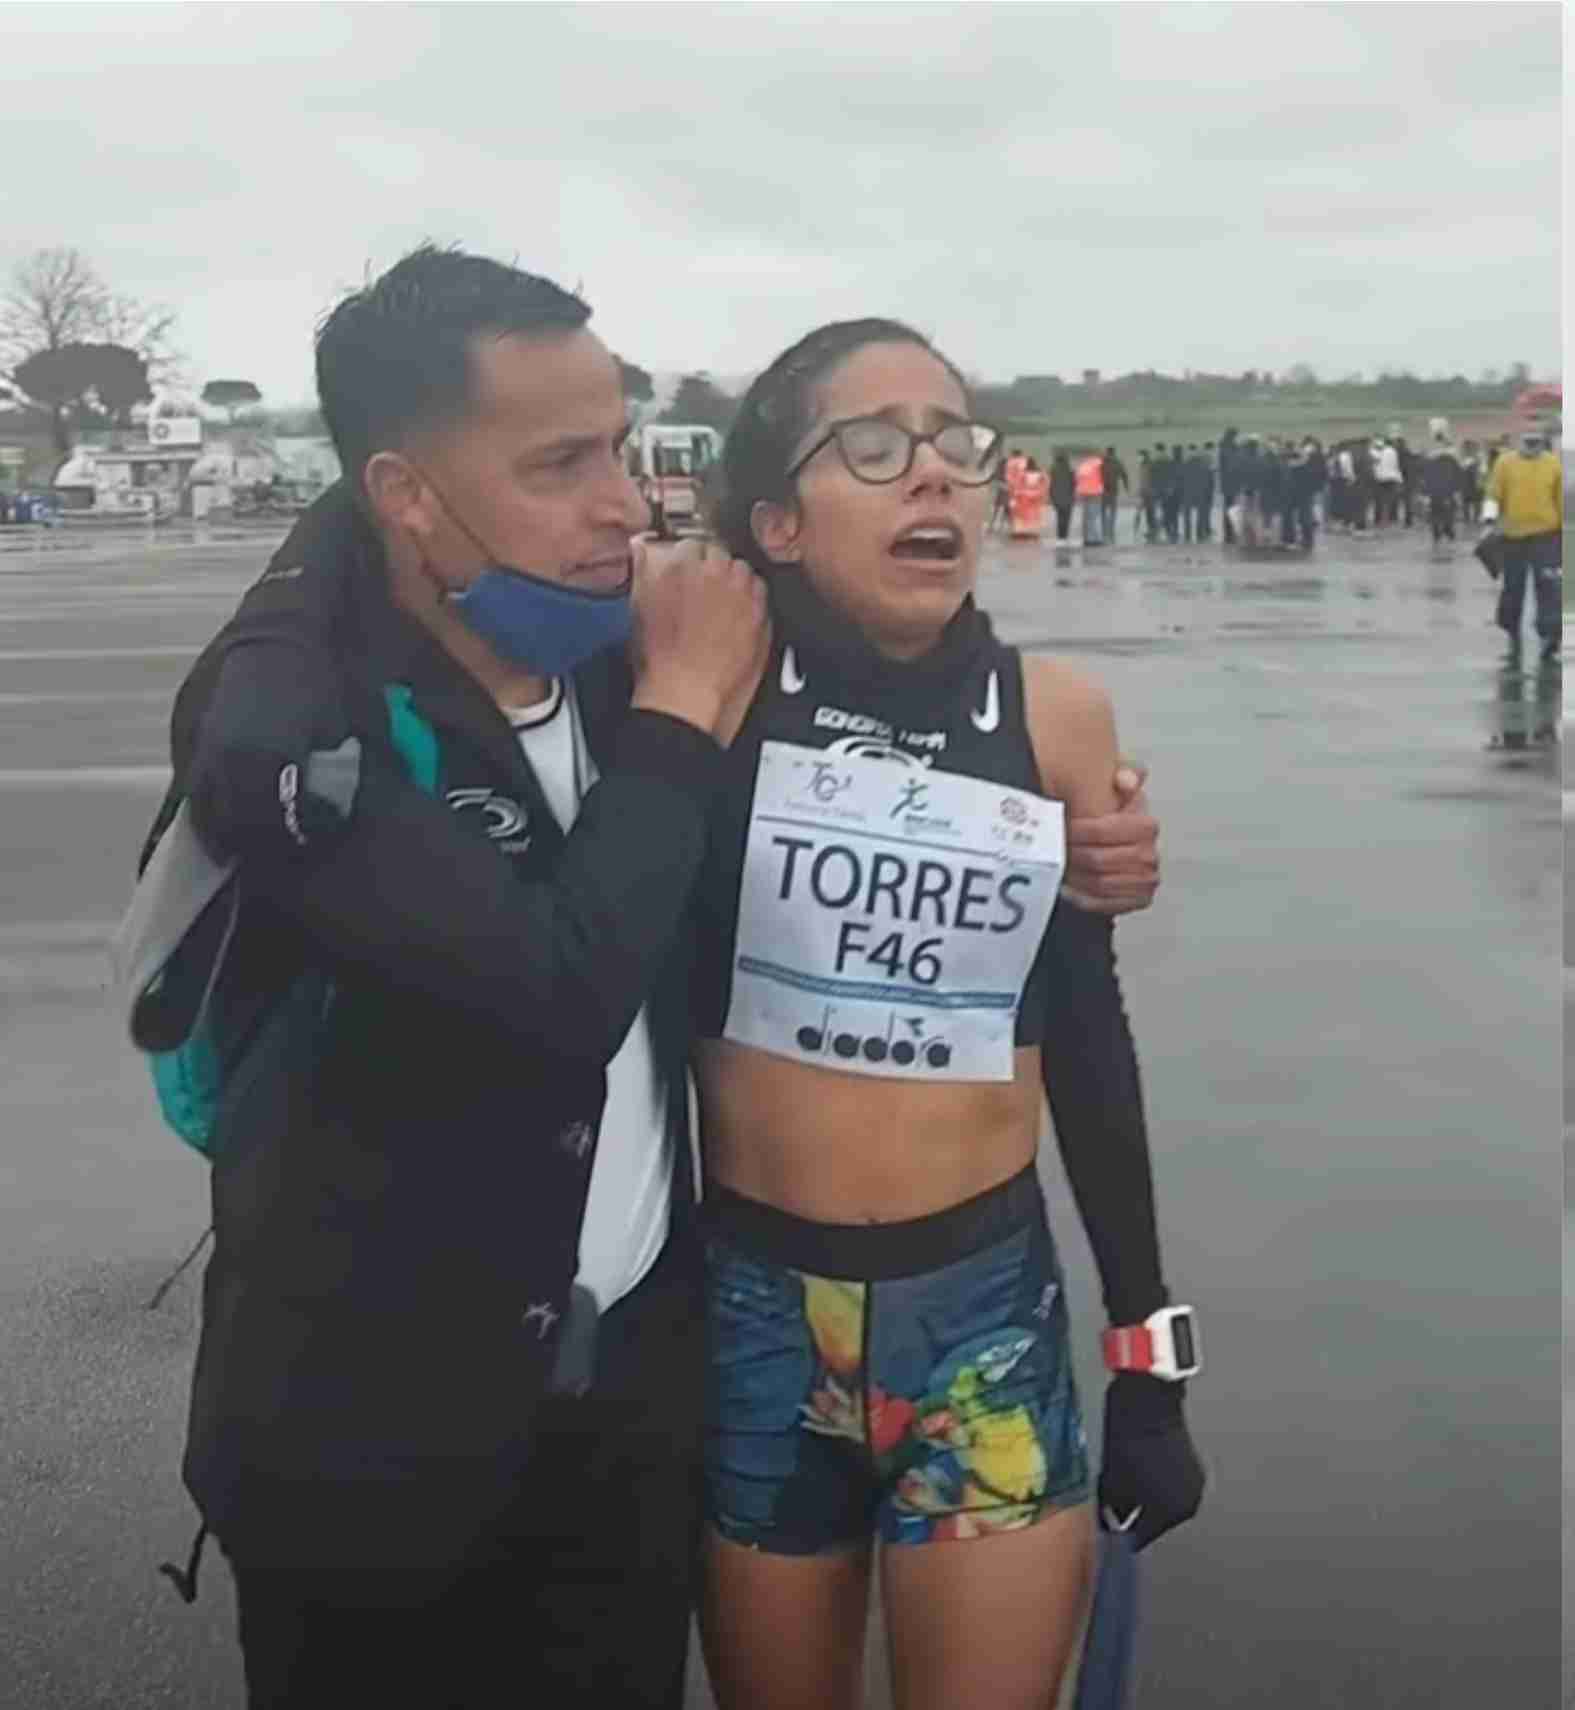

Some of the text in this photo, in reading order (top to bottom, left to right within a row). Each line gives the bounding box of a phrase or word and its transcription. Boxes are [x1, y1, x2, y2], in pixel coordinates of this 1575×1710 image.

[771, 834, 1031, 934] TORRES
[833, 921, 944, 987] F46
[795, 1003, 952, 1069] diadora
